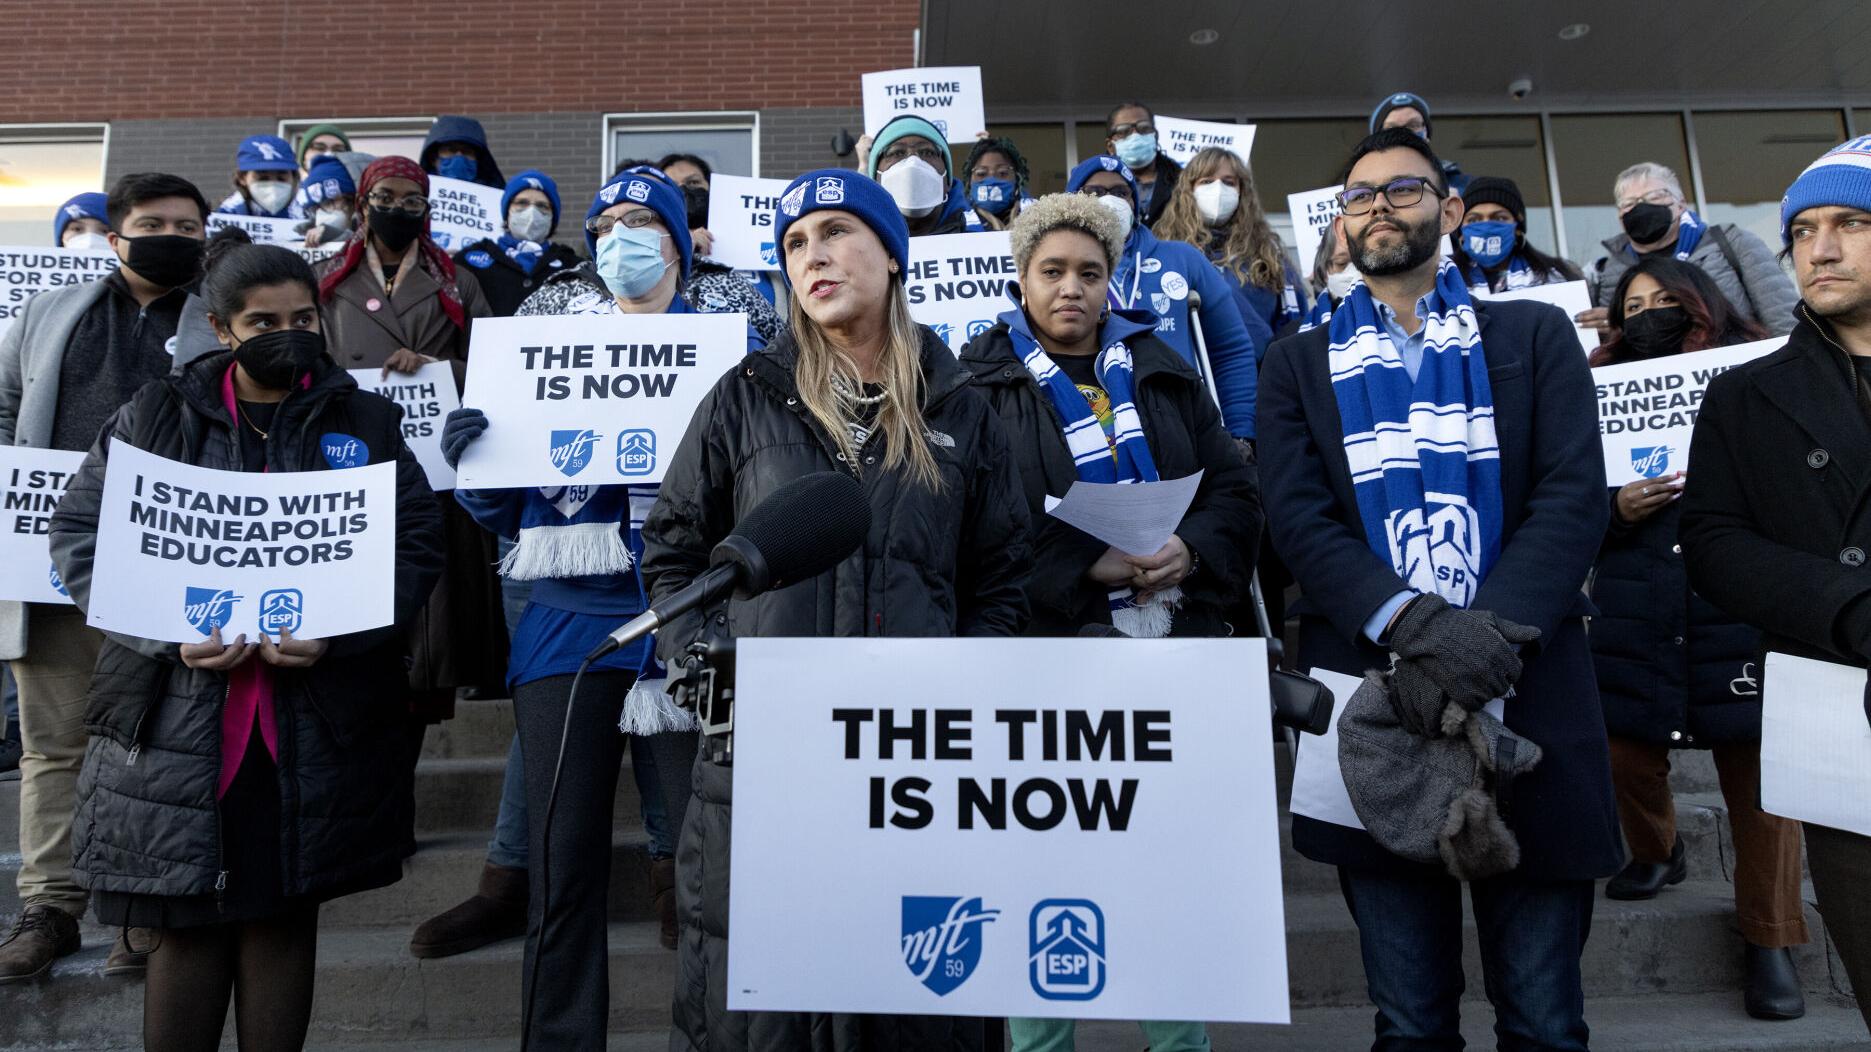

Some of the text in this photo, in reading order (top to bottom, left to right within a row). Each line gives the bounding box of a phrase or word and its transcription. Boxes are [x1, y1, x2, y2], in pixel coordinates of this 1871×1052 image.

[885, 82, 960, 96] THE TIME
[894, 96, 953, 109] IS NOW
[1170, 130, 1234, 145] THE TIME
[1174, 142, 1186, 152] IS
[430, 199, 487, 219] STABLE
[1307, 204, 1311, 213] I
[752, 213, 772, 226] IS
[947, 256, 1017, 276] TIME
[49, 272, 107, 286] SAF
[1163, 277, 1184, 293] YES
[934, 279, 1005, 301] NOW
[520, 344, 697, 370] THE TIME
[536, 374, 678, 401] IS NOW
[326, 440, 359, 463] mft
[551, 429, 603, 471] mft
[626, 454, 646, 464] ESP
[572, 459, 583, 468] 59
[11, 469, 19, 487] I
[134, 475, 366, 517] I STAND WITH
[569, 485, 588, 502] 59
[130, 501, 368, 542] MINNEAPOLIS
[140, 532, 353, 568] EDUCATORS
[184, 590, 245, 629] mft
[270, 613, 292, 624] ESP
[832, 708, 1173, 762] THE TIME
[869, 776, 1140, 832] IS NOW
[902, 896, 1001, 983] mft
[945, 959, 965, 977] 59
[1048, 954, 1088, 975] ESP
